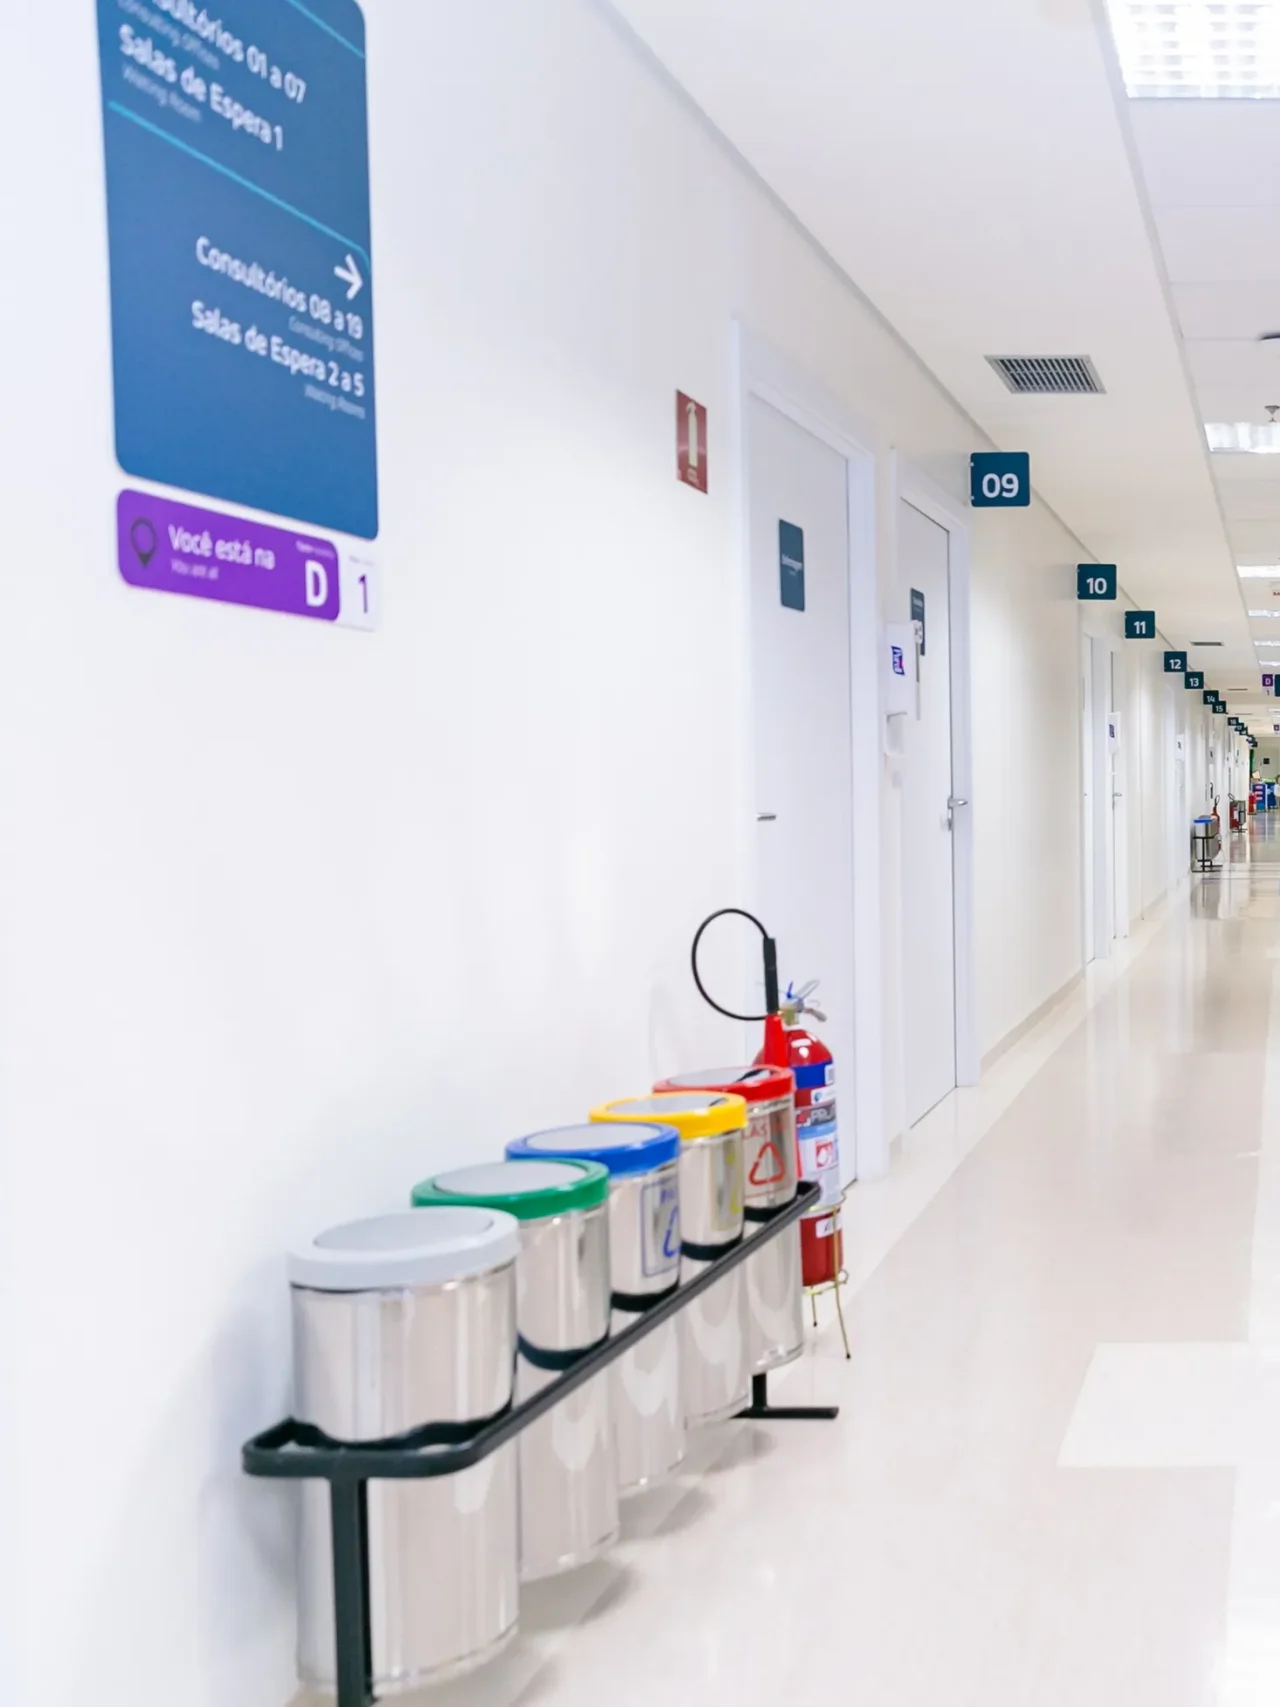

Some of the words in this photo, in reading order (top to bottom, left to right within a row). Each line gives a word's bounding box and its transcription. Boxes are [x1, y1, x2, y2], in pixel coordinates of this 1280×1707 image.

[119, 24, 178, 83] Salas
[181, 66, 207, 102] de
[210, 82, 272, 144] Espera
[274, 125, 283, 150] 1
[247, 45, 267, 79] 01
[270, 65, 282, 89] a
[285, 72, 306, 103] 07
[196, 236, 307, 312] Consultórios
[334, 310, 345, 331] a
[191, 300, 243, 345] Salas
[244, 324, 268, 356] de
[270, 335, 327, 381] Espera
[328, 360, 339, 387] 2
[341, 371, 353, 392] a
[354, 372, 366, 397] 5
[982, 472, 1019, 498] 09
[168, 524, 213, 558] Você
[215, 539, 252, 566] está
[254, 547, 275, 571] na
[305, 559, 328, 607] D
[359, 573, 368, 614] 1
[1086, 577, 1108, 595] 10
[1133, 621, 1146, 635] 11
[1169, 658, 1182, 670] 12
[1189, 677, 1200, 687] 13
[1206, 695, 1216, 703] 14
